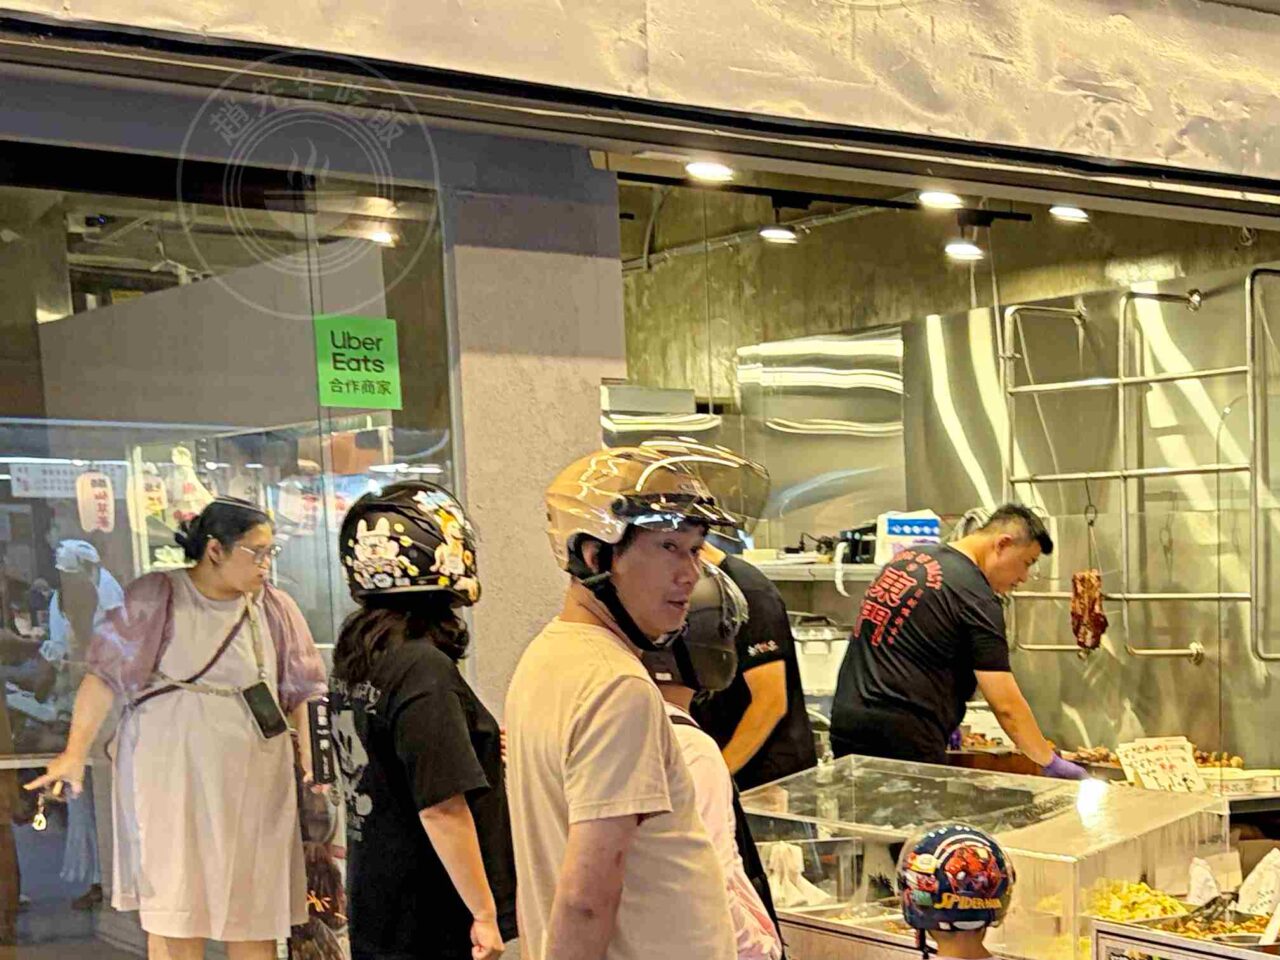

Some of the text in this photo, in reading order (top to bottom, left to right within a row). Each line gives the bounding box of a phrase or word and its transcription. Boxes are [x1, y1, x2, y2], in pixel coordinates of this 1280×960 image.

[330, 330, 383, 351] Uber
[332, 352, 385, 373] Eats
[329, 378, 392, 395] 合作商家
